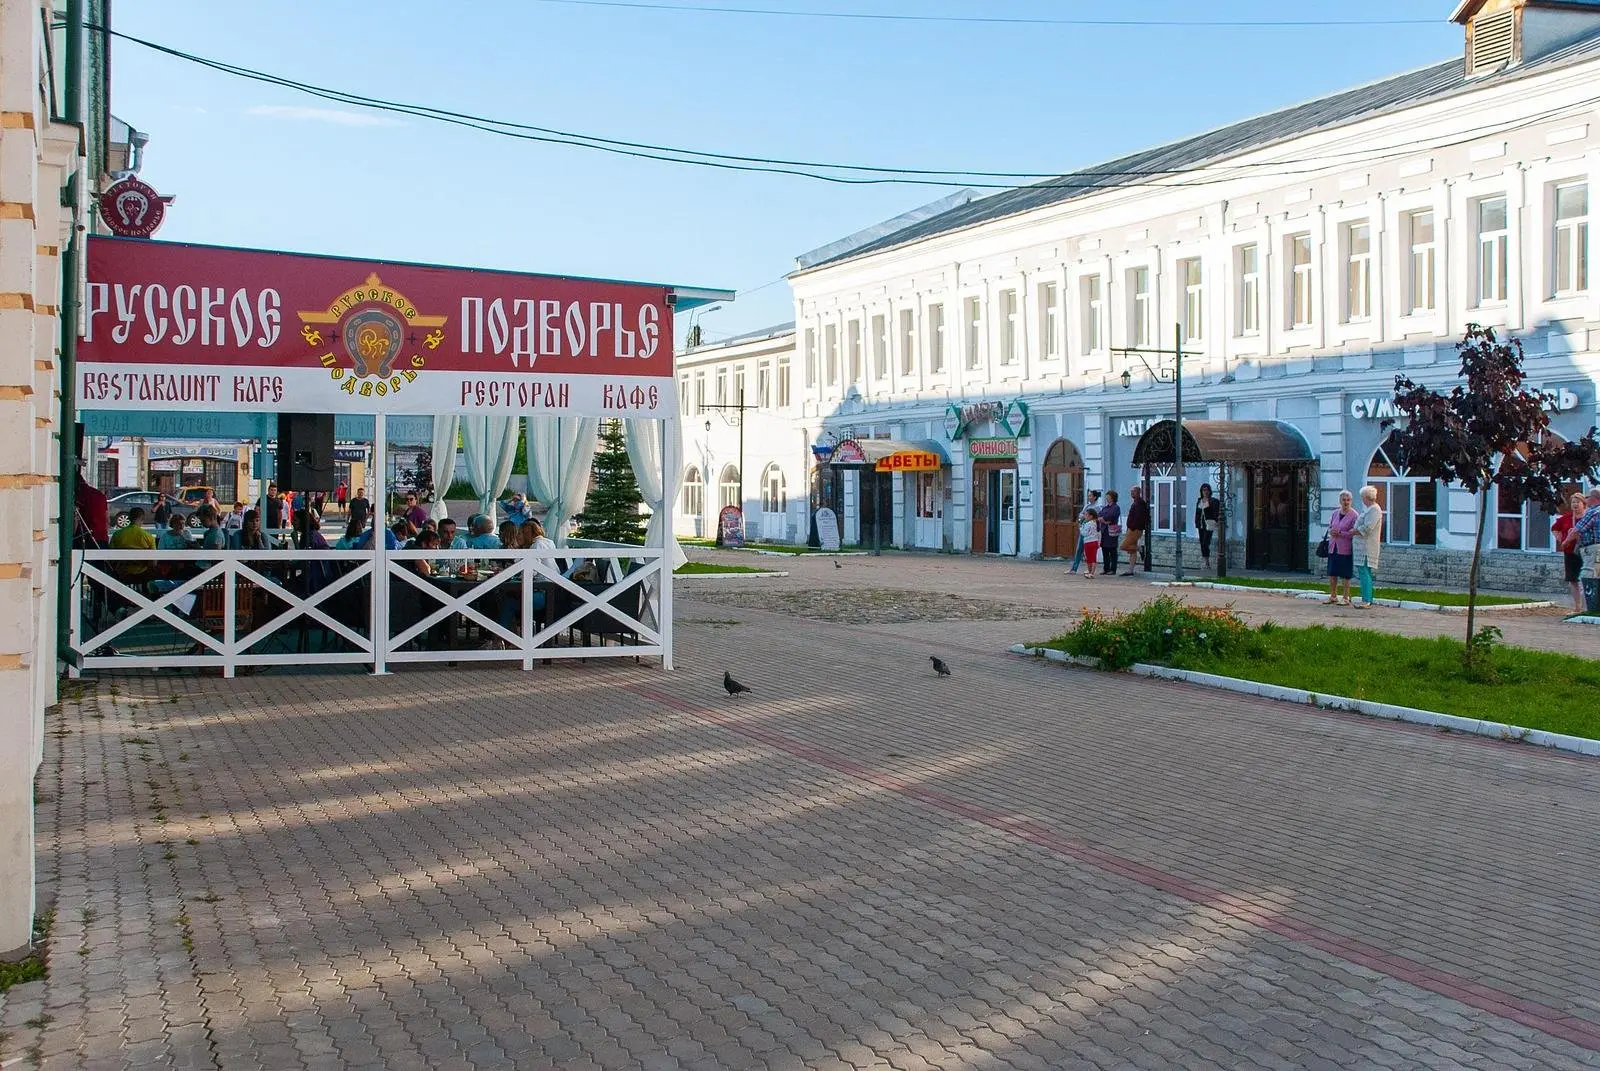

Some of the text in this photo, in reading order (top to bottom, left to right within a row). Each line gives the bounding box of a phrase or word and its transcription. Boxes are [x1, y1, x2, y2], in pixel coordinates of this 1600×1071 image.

[331, 288, 416, 319] РУССКОЕ
[84, 282, 281, 348] РУССКОЕ
[461, 297, 659, 368] ПОДВОРЬЕ
[83, 372, 283, 403] RESTARAUNT KAFE
[319, 351, 425, 397] ПОДВОРЬЕ
[461, 380, 658, 410] РЕСТОРАН КАФЕ
[1119, 419, 1144, 436] ART
[879, 454, 937, 470] ЦВЕТЫ
